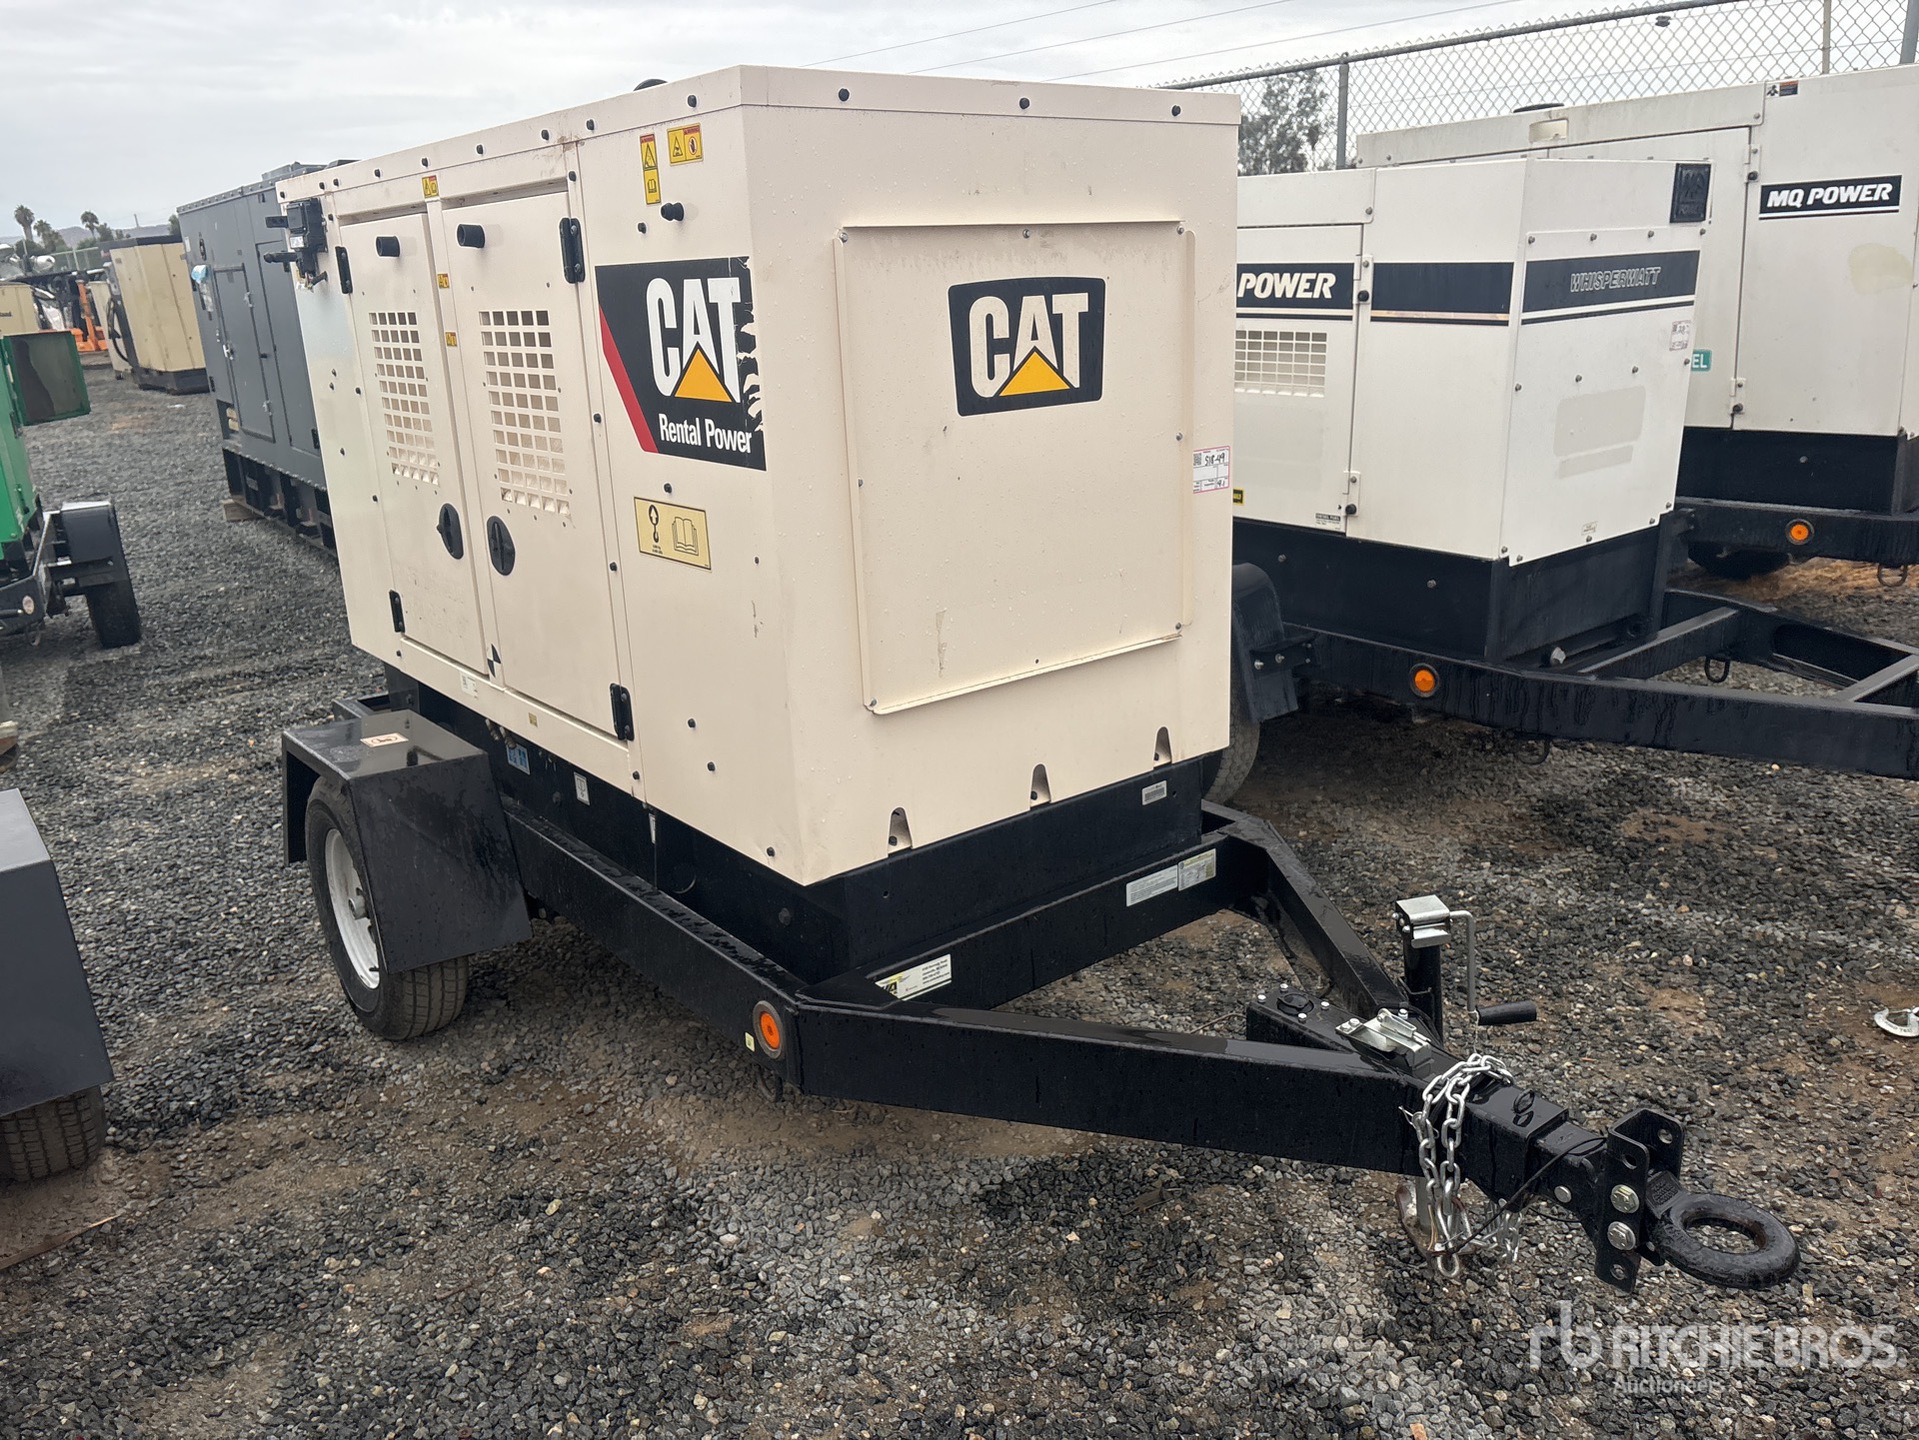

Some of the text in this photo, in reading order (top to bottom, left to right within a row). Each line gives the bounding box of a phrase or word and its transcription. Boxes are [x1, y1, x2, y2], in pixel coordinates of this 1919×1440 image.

[1766, 183, 1893, 208] MQ POWER
[1236, 272, 1337, 299] POWER
[1570, 266, 1662, 293] WHISPERWATT
[646, 277, 741, 403] CAT
[968, 292, 1089, 398] CAT
[1691, 353, 1708, 368] EL
[658, 413, 753, 454] Rental Power
